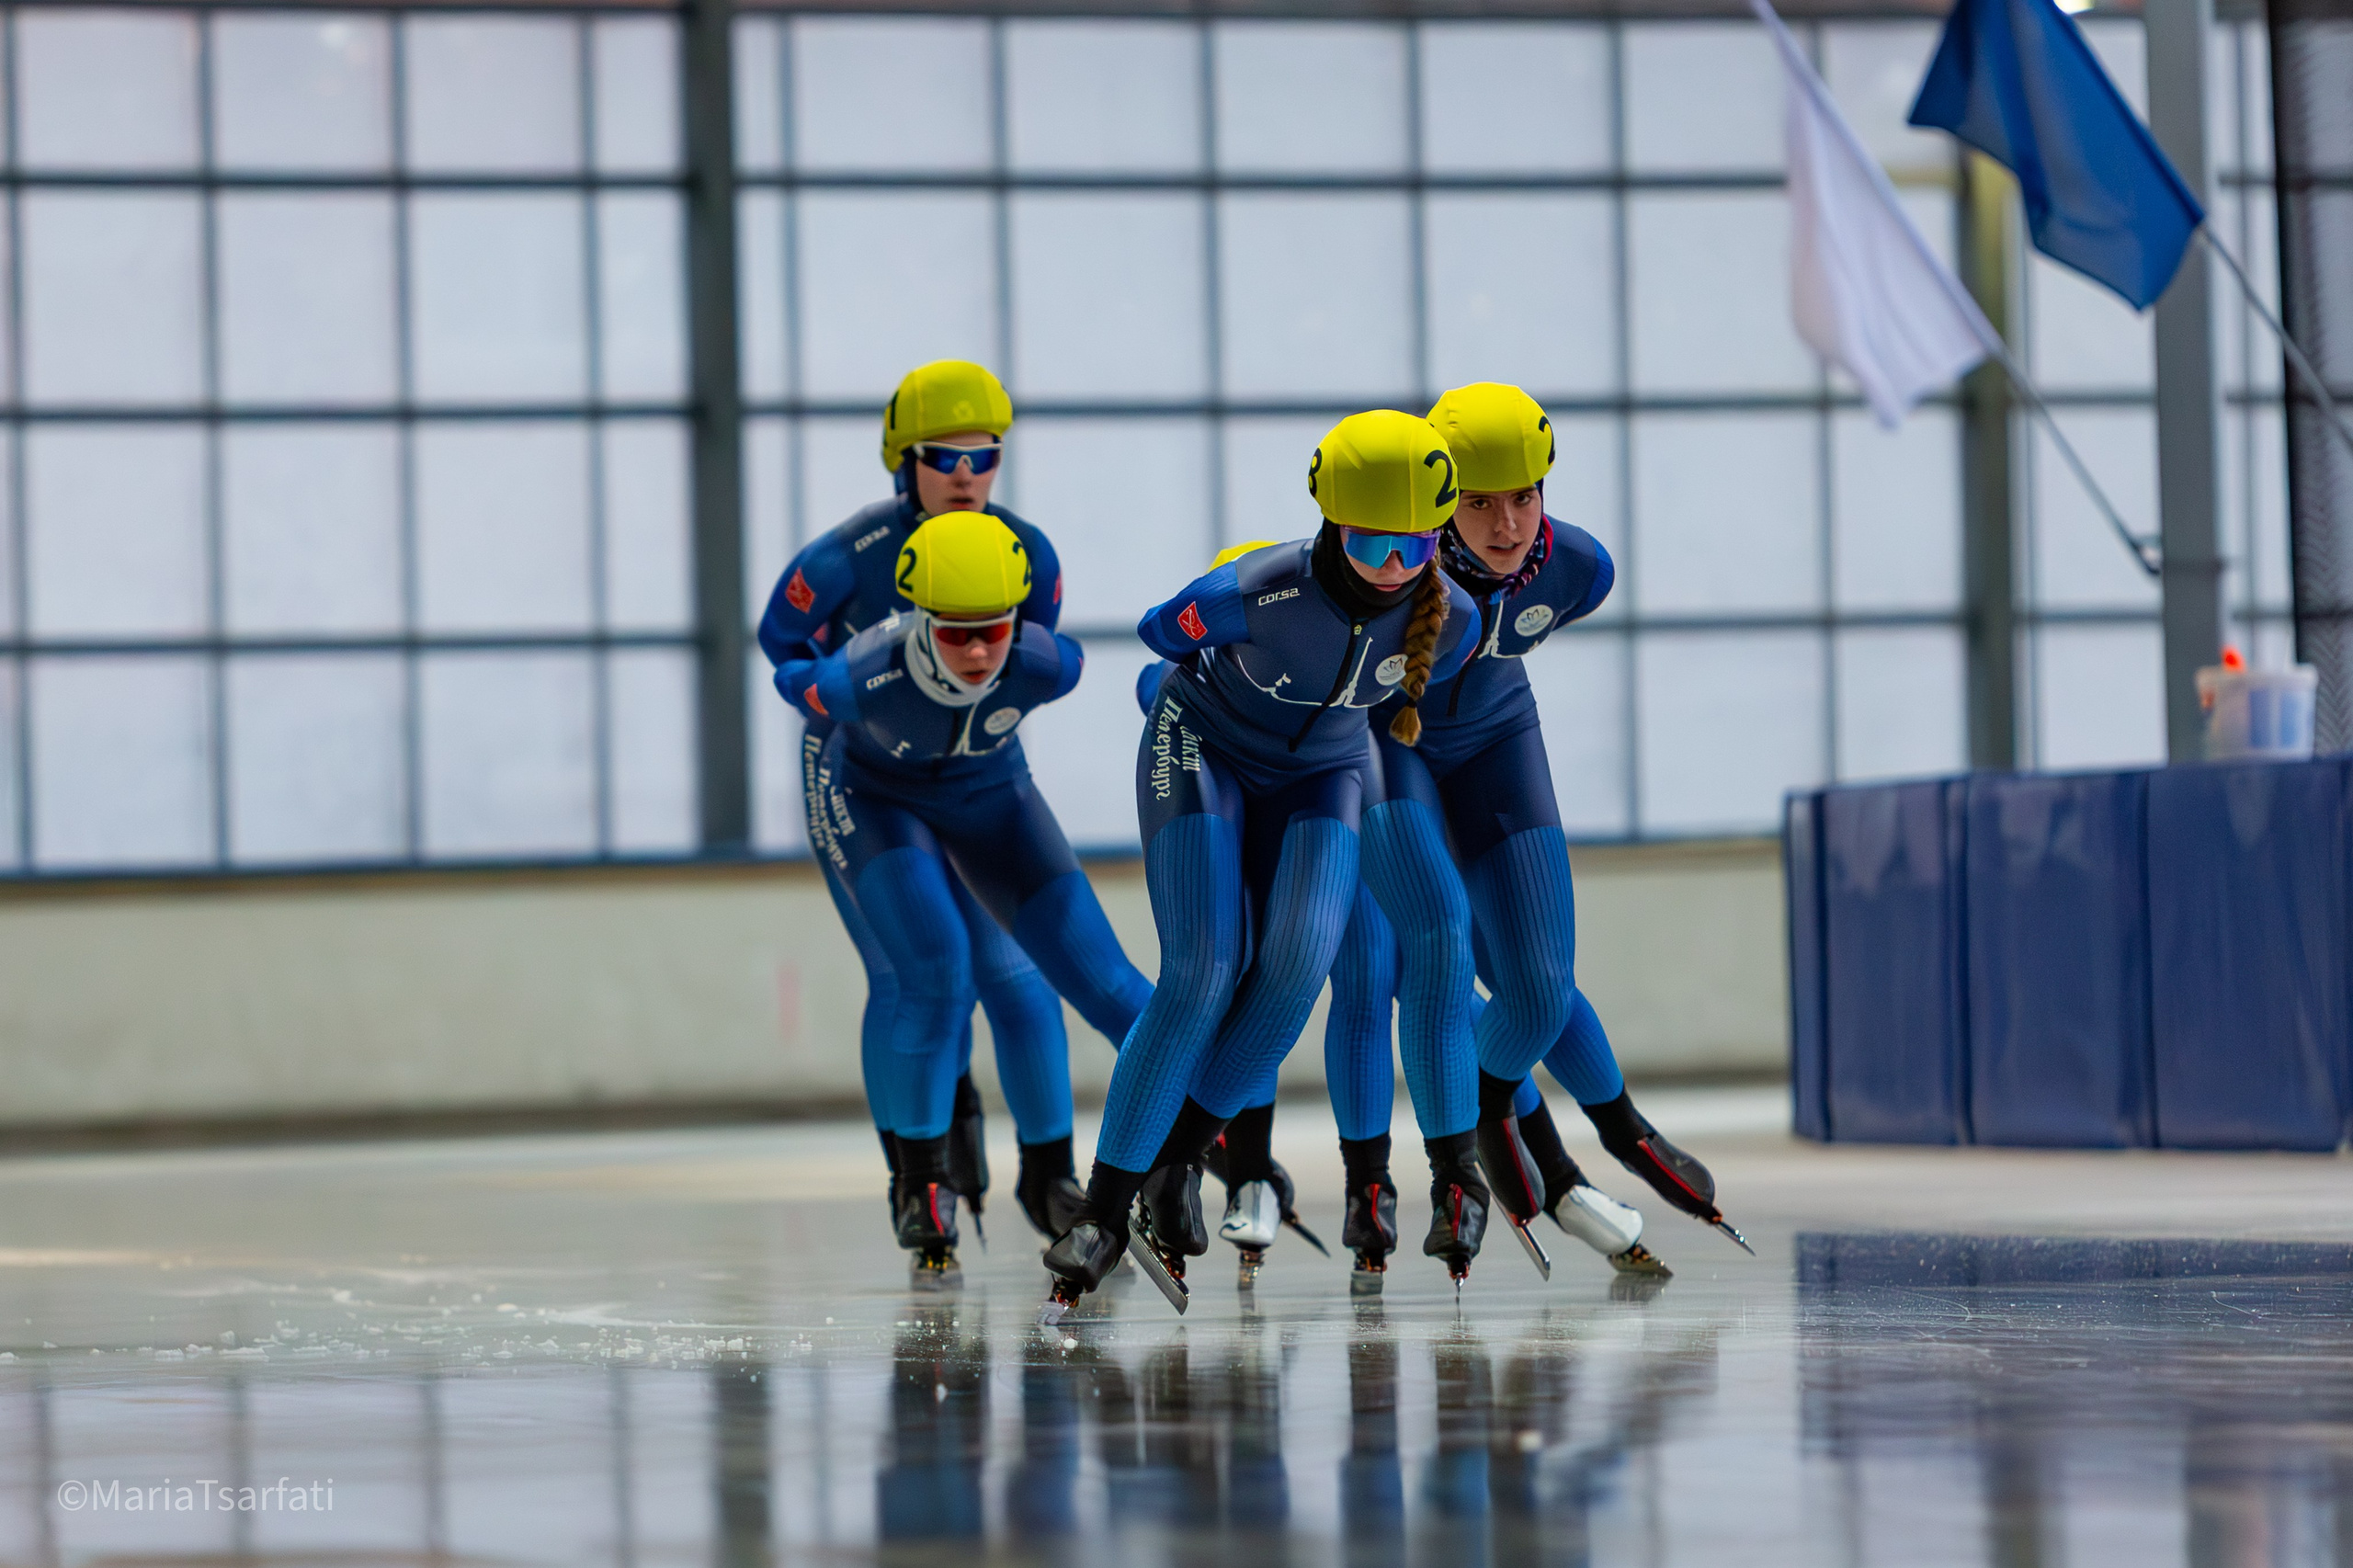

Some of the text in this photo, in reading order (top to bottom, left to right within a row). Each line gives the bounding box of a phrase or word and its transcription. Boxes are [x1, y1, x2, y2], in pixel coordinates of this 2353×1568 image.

[1424, 449, 1457, 508] 2
[898, 547, 916, 593] 2
[1258, 587, 1301, 607] corsa
